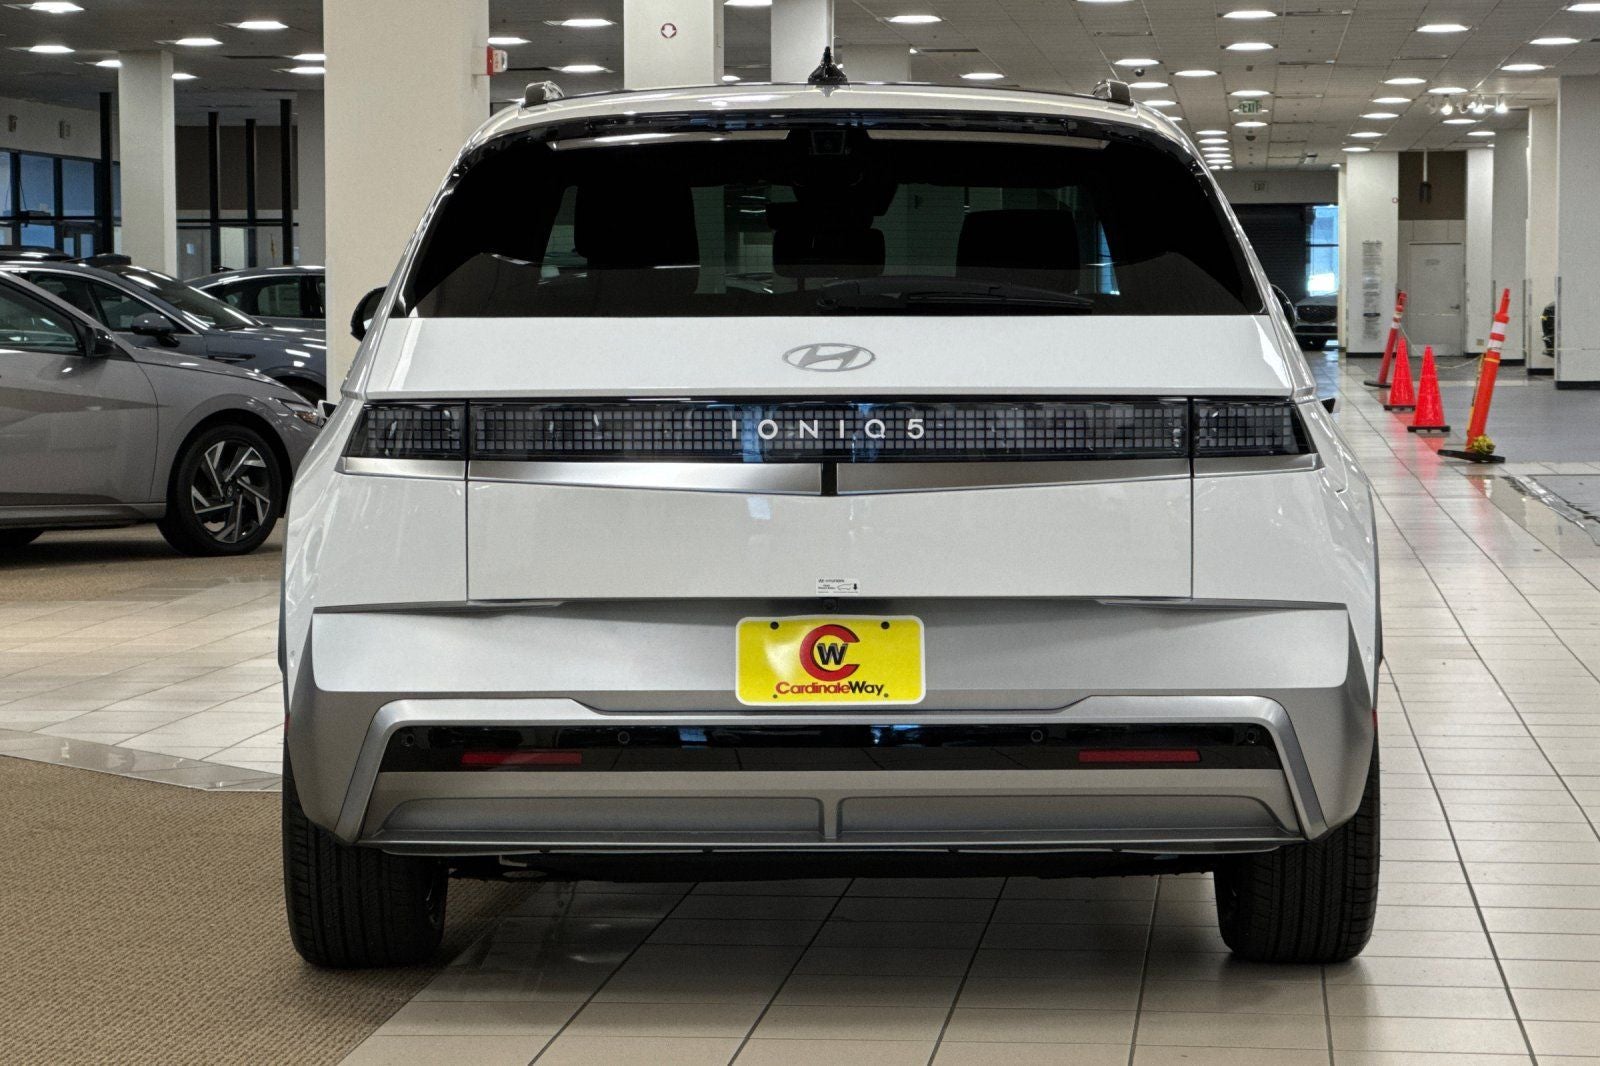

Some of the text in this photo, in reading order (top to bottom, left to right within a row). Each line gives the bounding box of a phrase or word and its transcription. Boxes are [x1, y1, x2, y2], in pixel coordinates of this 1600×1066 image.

[1242, 102, 1259, 113] EXIT
[731, 418, 925, 439] IONIQ 5
